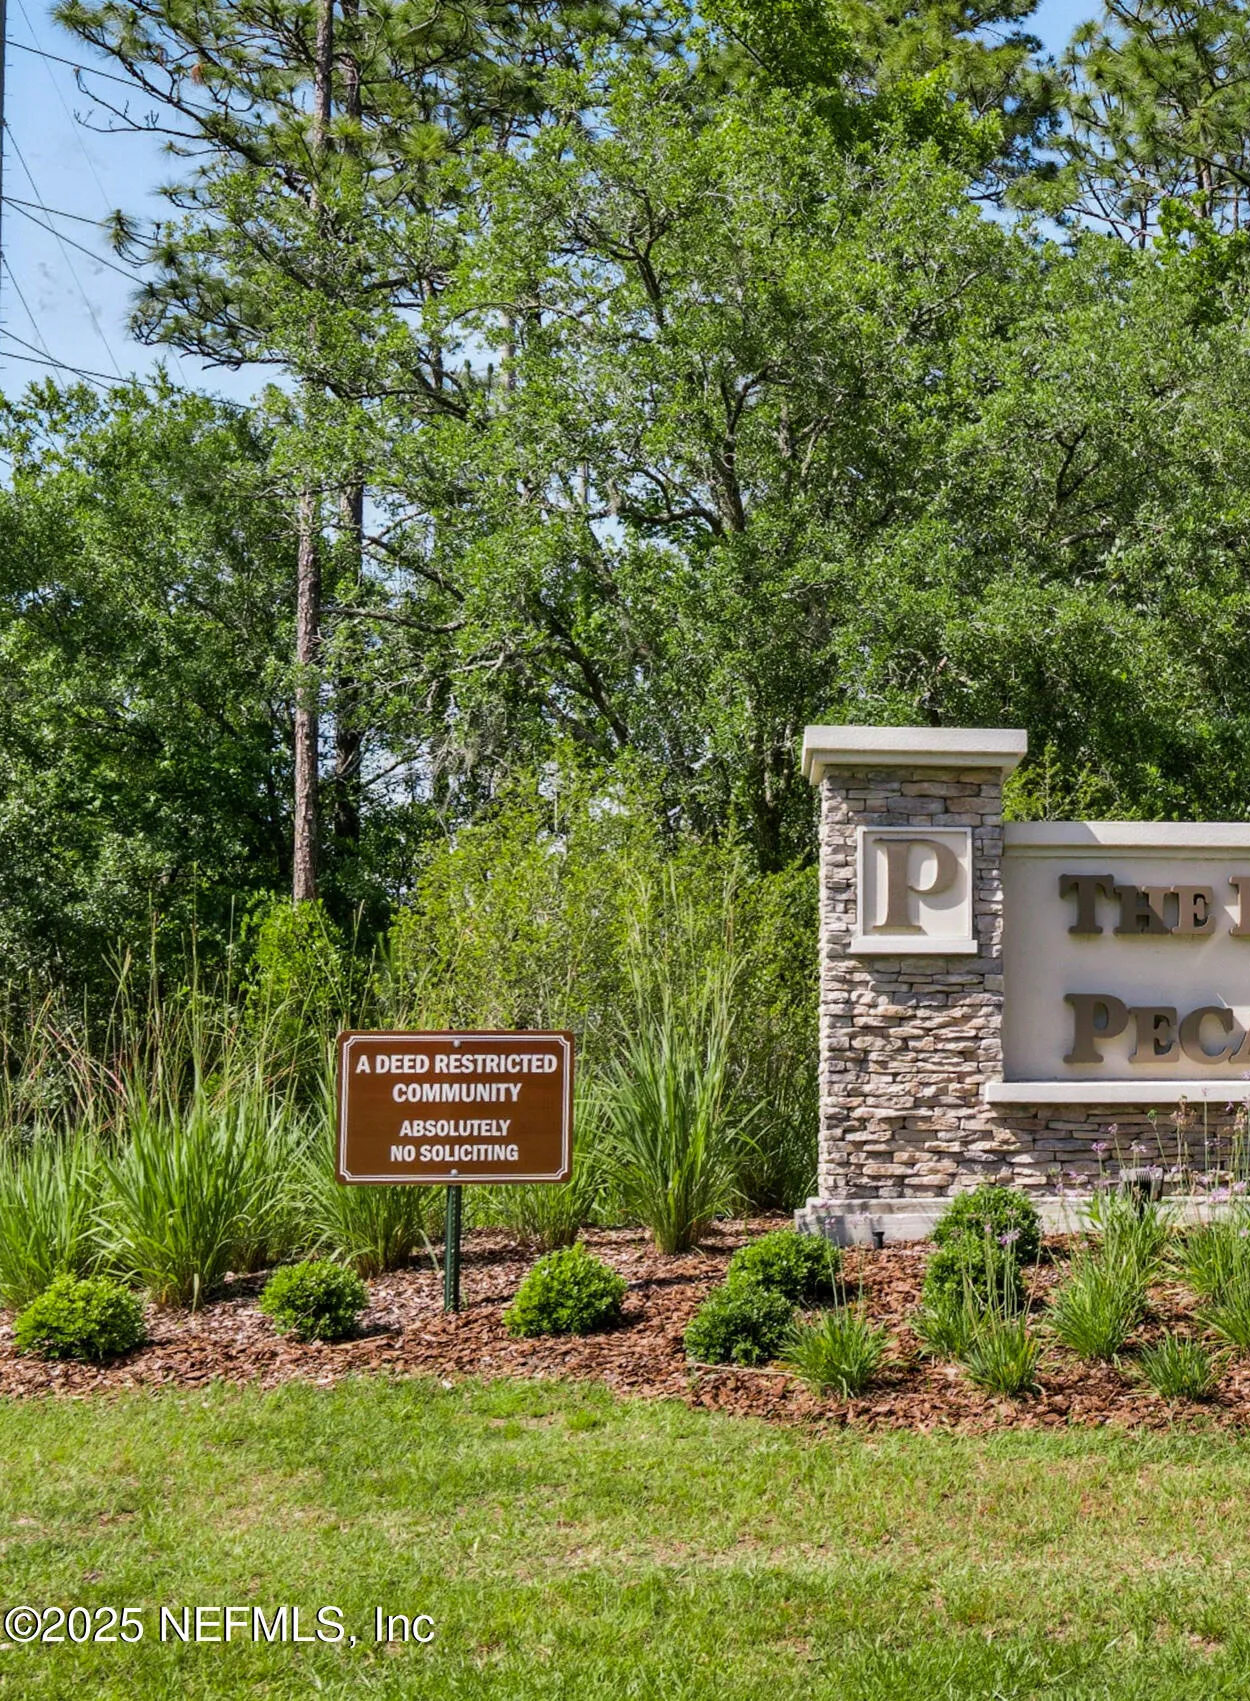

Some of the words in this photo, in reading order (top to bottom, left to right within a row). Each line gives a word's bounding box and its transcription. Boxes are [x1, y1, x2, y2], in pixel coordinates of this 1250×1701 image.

[872, 838, 959, 932] P
[1059, 873, 1216, 935] THE
[355, 1055, 371, 1074] A
[376, 1054, 430, 1074] DEED
[434, 1054, 558, 1074] RESTRICTED
[392, 1083, 522, 1103] COMMUNITY
[399, 1119, 511, 1137] ABSOLUTELY
[390, 1145, 416, 1162] NO
[419, 1144, 519, 1162] SOLICITING
